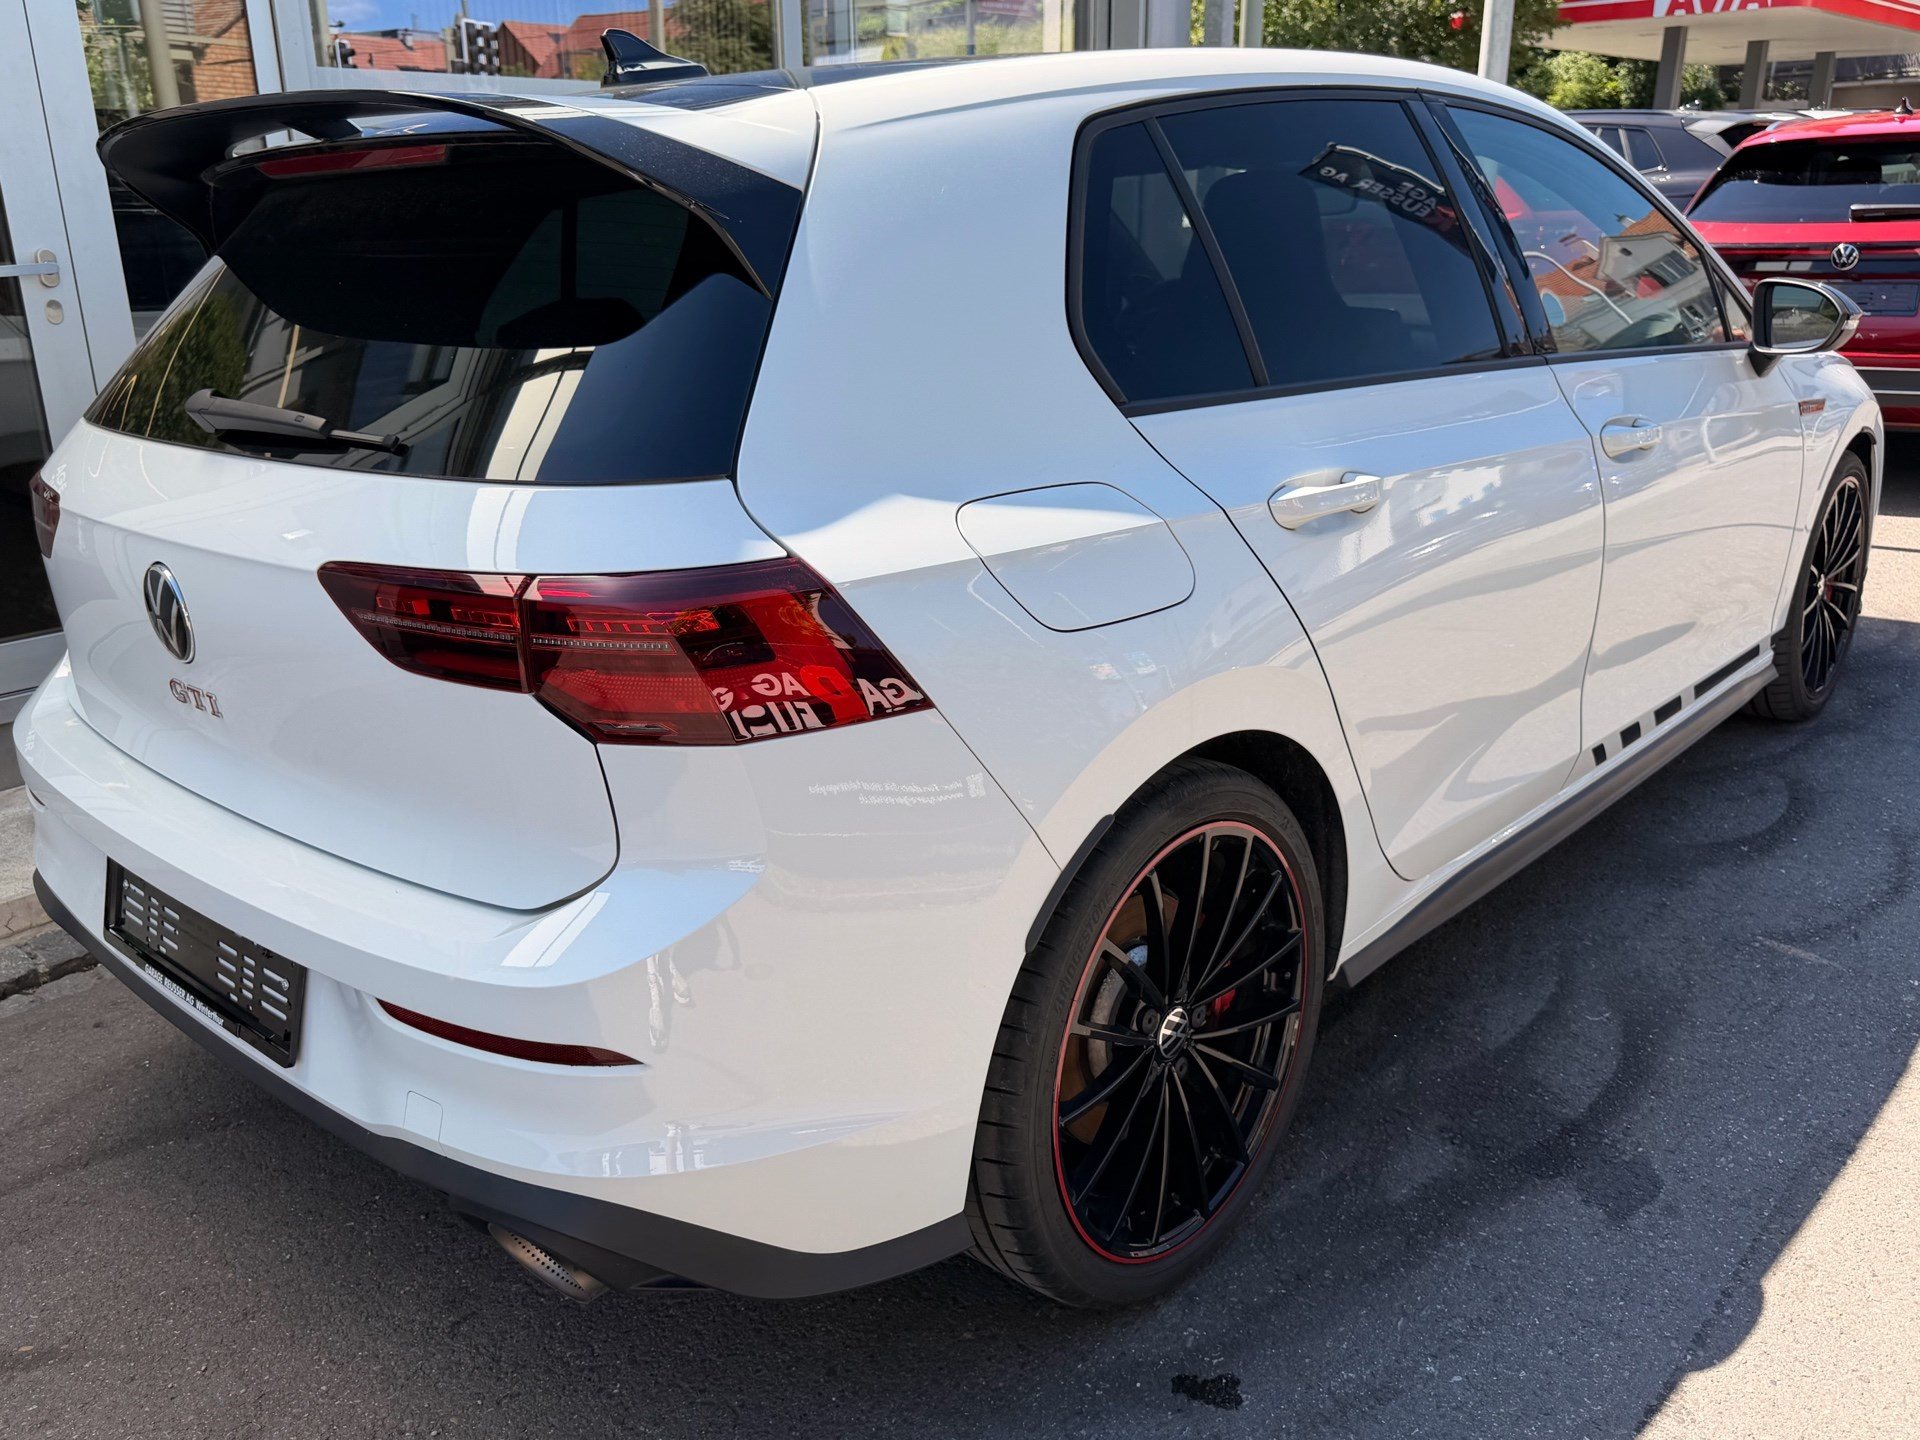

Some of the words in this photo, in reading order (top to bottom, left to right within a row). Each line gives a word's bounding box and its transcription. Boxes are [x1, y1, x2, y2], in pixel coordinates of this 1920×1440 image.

[169, 677, 223, 719] GTI
[144, 963, 164, 985] GARAGE
[163, 976, 186, 1001] REUSSER
[195, 999, 225, 1027] Winterthur
